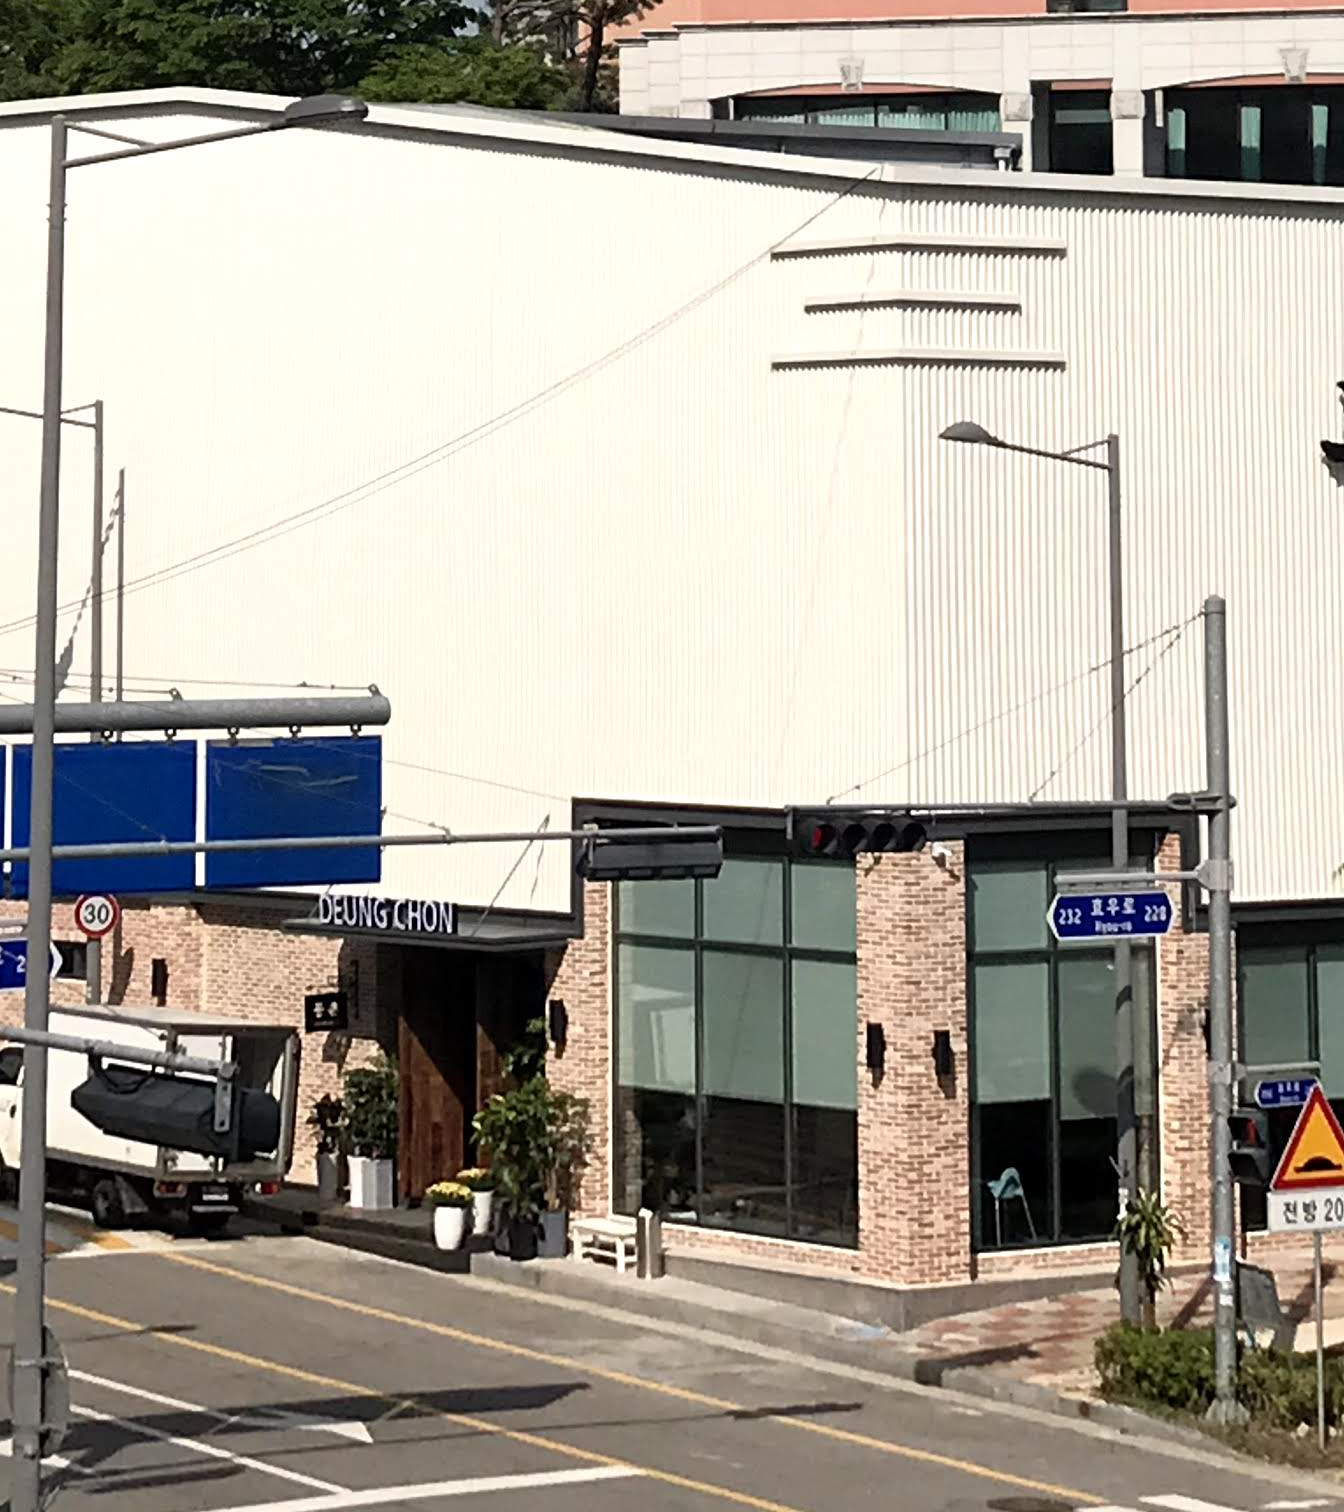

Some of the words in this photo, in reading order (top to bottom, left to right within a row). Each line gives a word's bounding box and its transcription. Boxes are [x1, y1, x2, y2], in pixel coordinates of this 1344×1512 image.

[83, 903, 109, 925] 30
[319, 894, 388, 929] DEUNG
[392, 899, 454, 934] CHON
[1058, 908, 1083, 926] 232
[1090, 896, 1137, 917] 효우로
[1283, 1199, 1317, 1224] 전방
